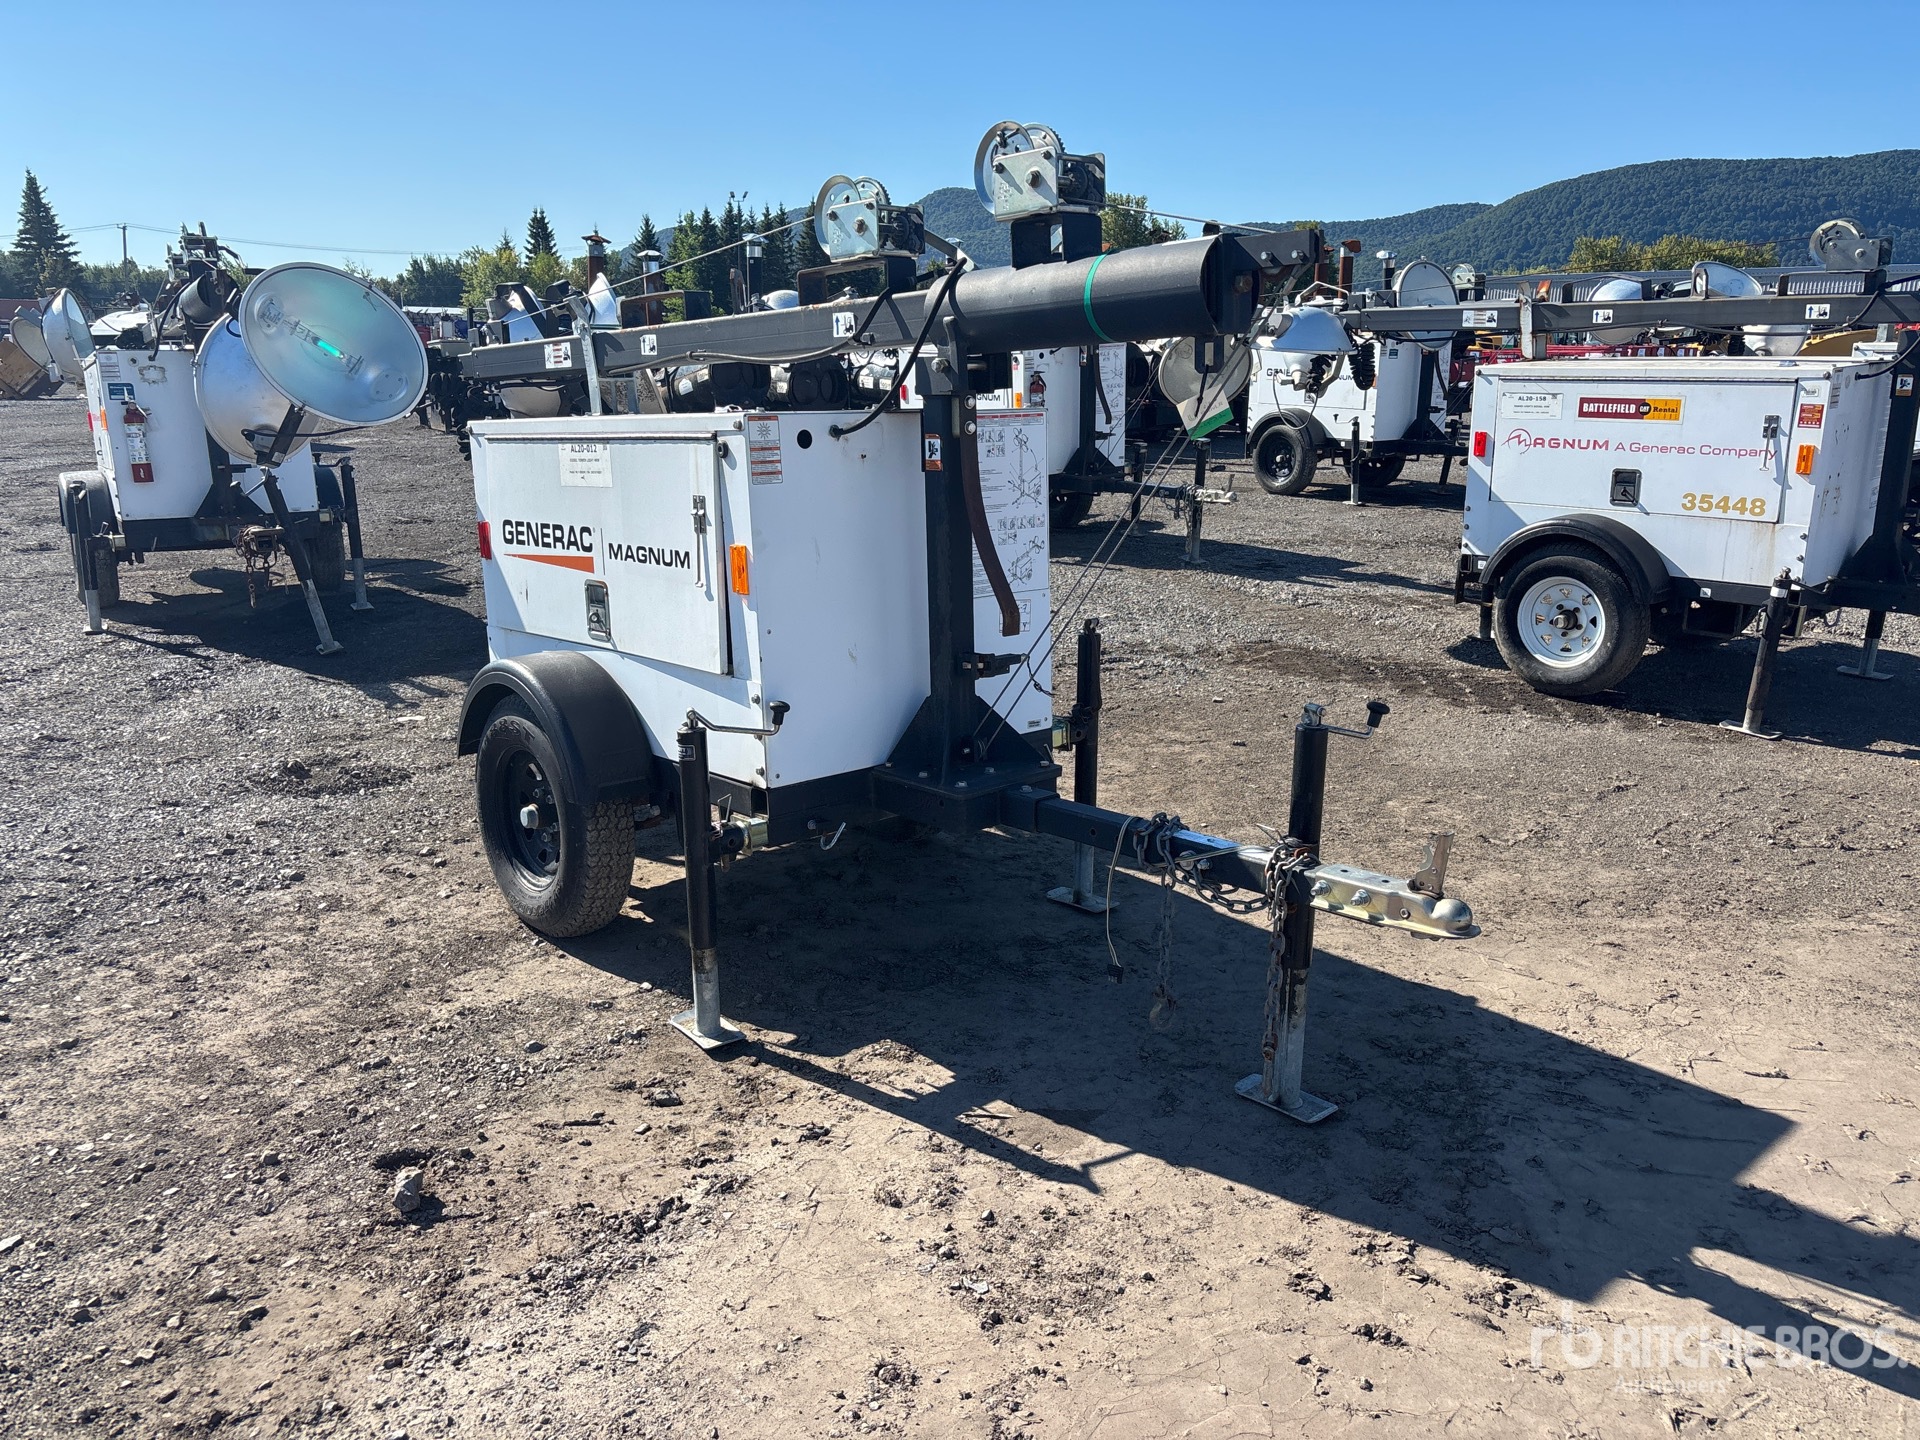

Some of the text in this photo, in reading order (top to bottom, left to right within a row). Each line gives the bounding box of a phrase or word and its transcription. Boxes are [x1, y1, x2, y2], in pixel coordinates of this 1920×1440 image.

[1582, 403, 1636, 413] BATTLEFIELD
[1614, 442, 1626, 451] A
[1629, 442, 1696, 455] Generac
[1699, 444, 1778, 460] Company
[1681, 492, 1766, 517] 35448
[502, 519, 691, 569] GENERAC MAGNUM
